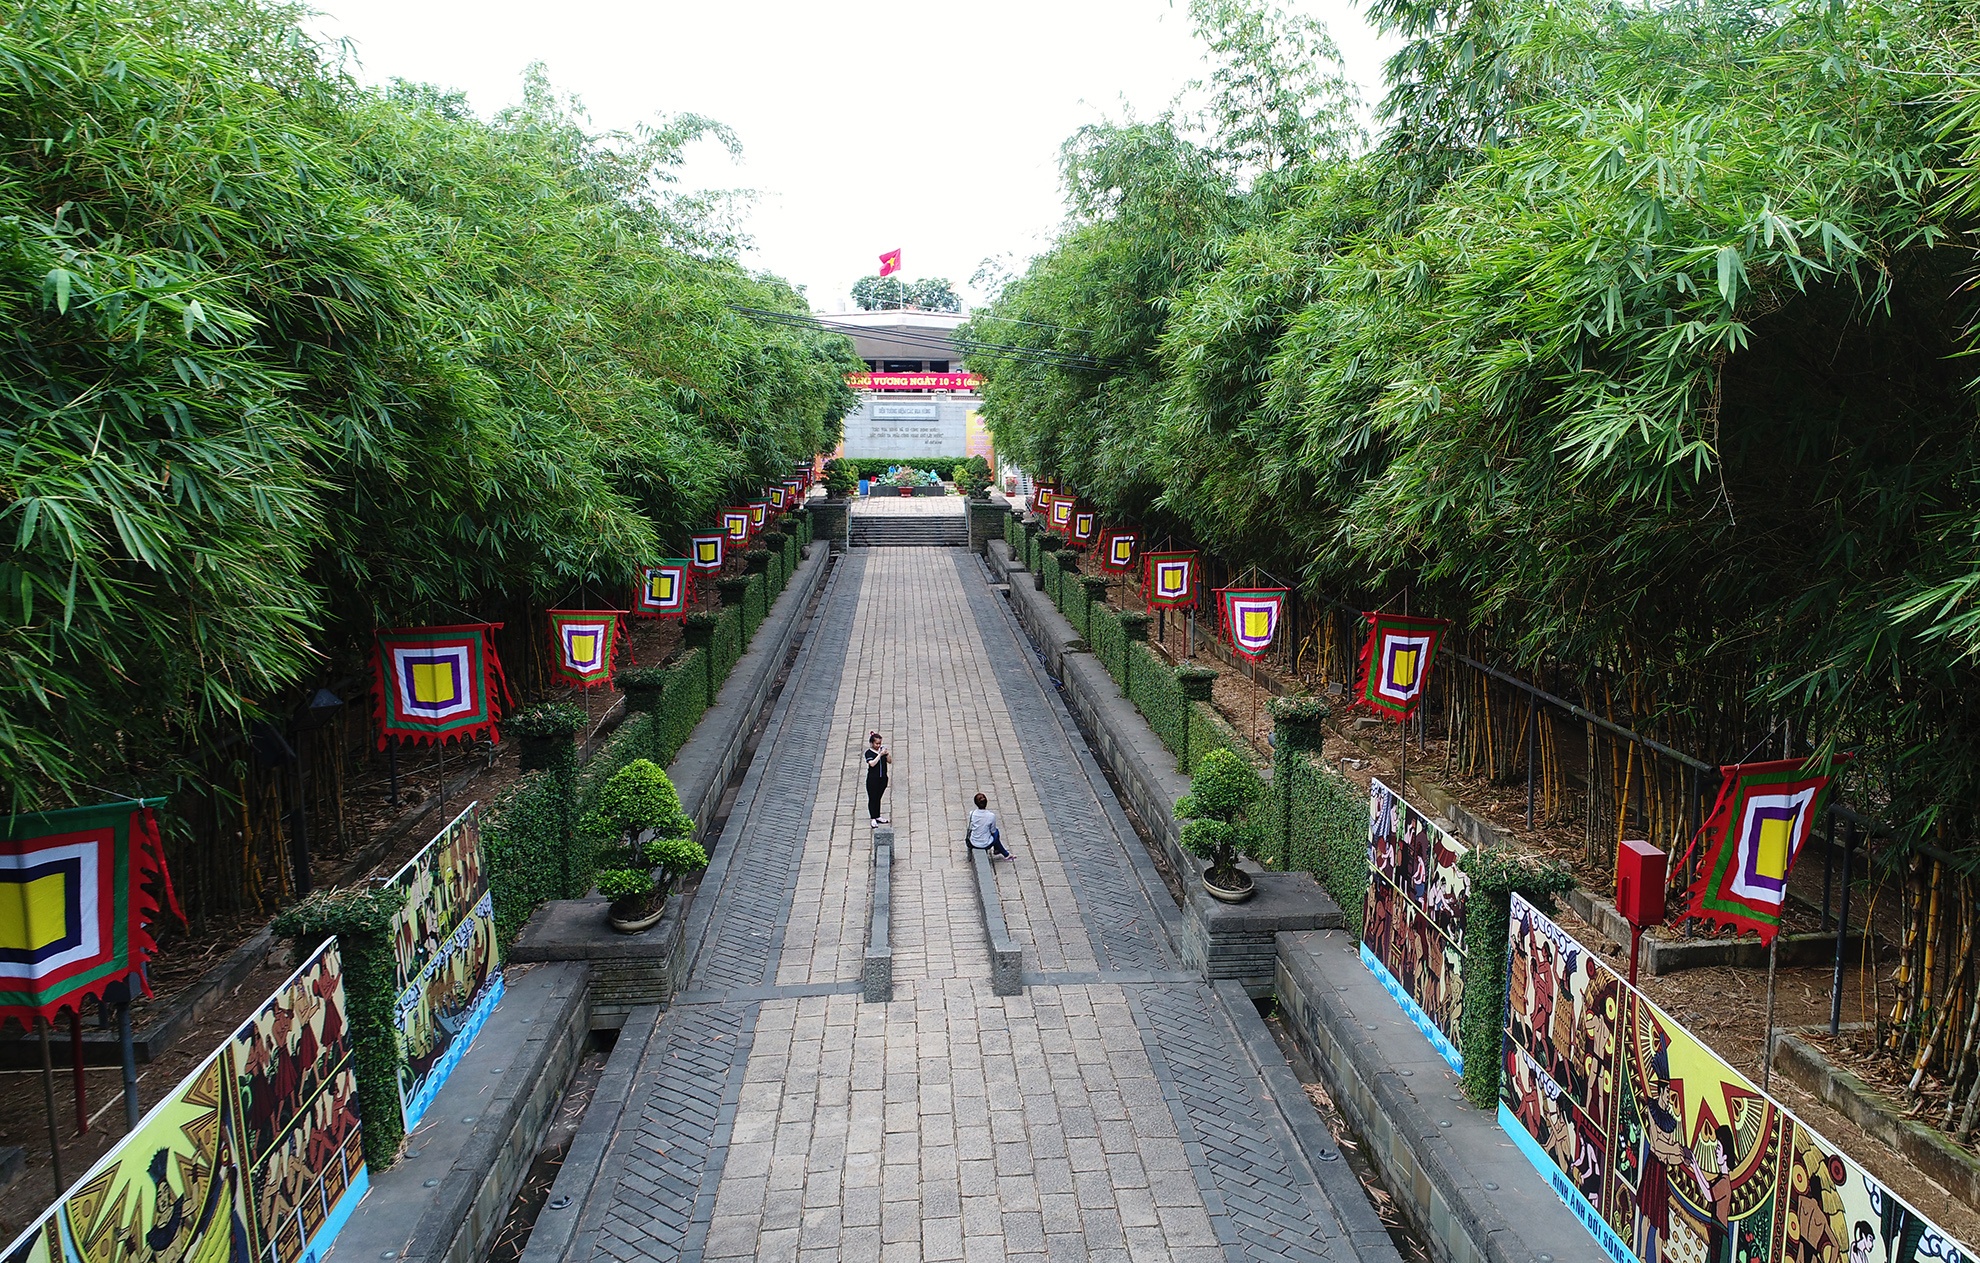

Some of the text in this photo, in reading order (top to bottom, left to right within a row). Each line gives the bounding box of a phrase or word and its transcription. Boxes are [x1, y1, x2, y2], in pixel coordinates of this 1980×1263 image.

[873, 376, 908, 386] VƯƠNG
[909, 375, 937, 386] NGÀY
[939, 377, 949, 386] 10
[955, 377, 962, 386] 3
[1552, 1171, 1625, 1263] HÌNH ẢNH ĐỜI SỐNG
